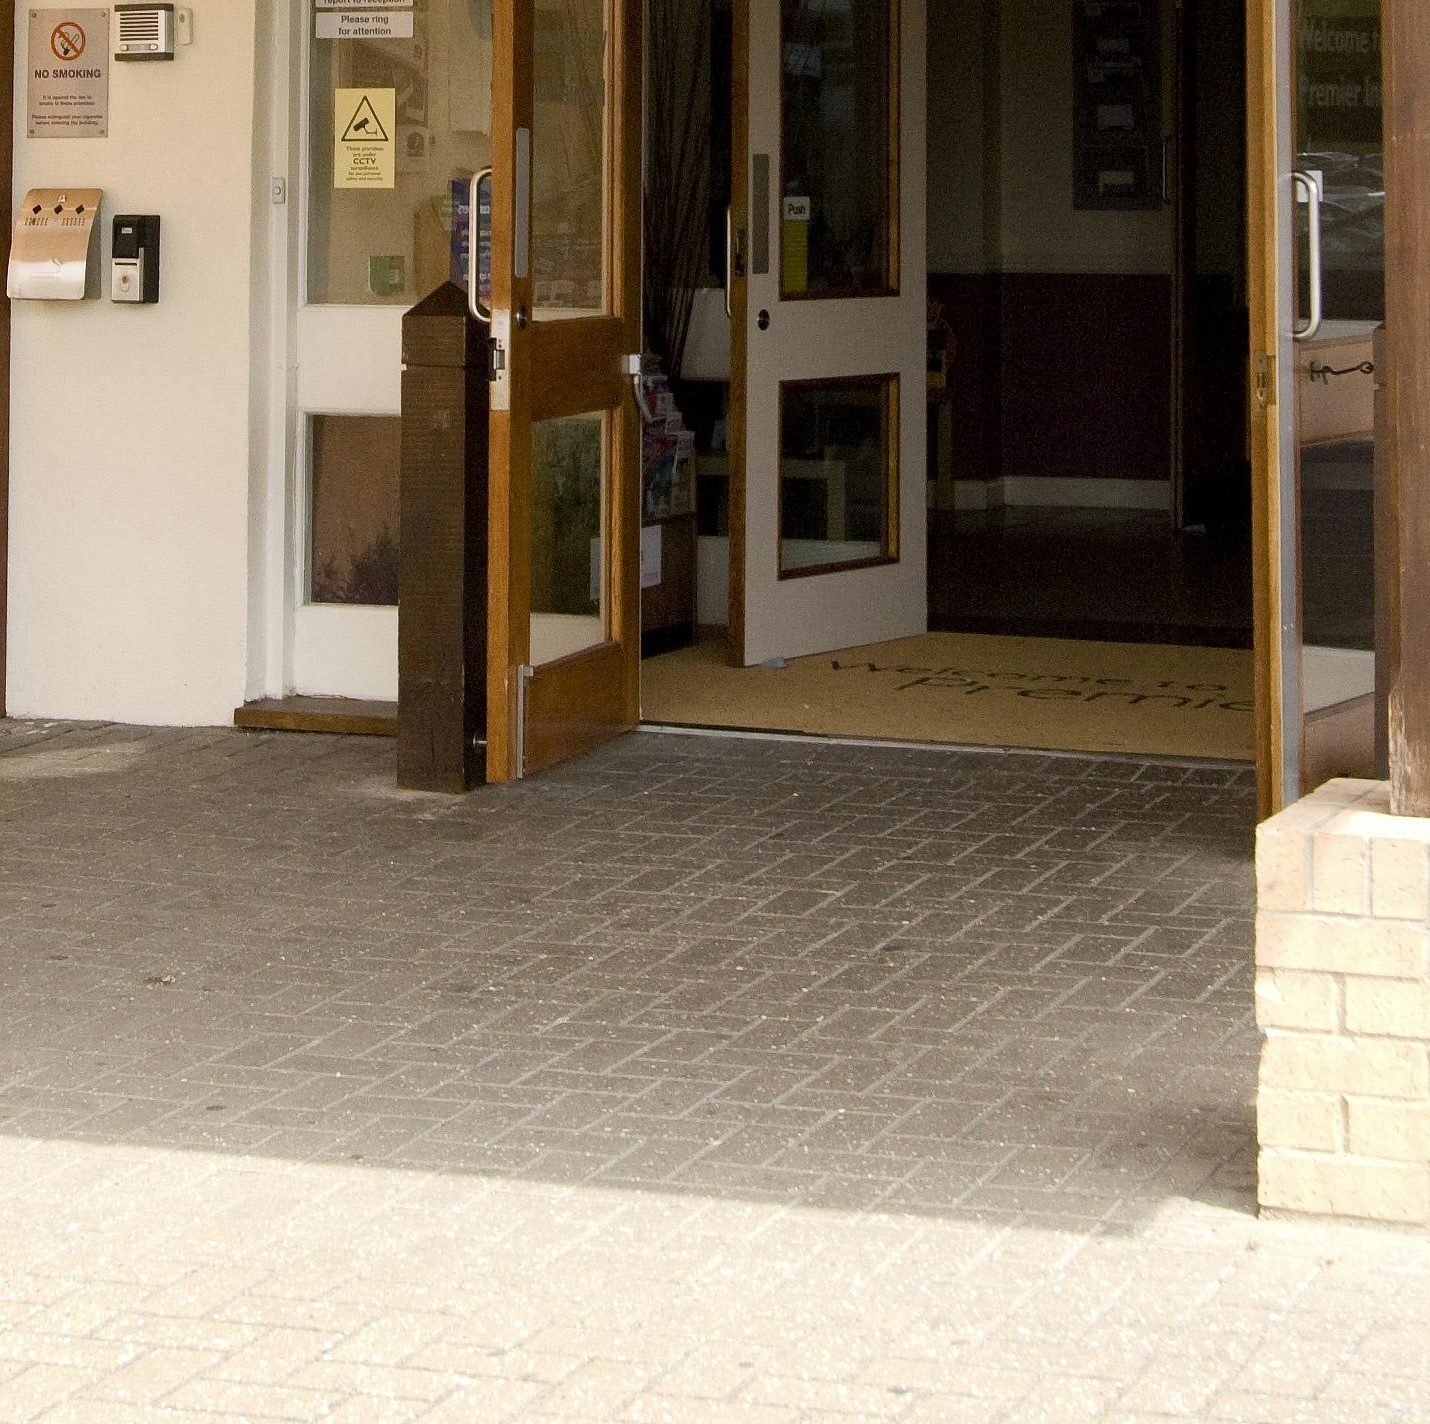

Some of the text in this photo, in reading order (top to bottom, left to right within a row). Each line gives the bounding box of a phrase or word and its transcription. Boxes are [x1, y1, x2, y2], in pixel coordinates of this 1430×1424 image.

[341, 15, 389, 24] Please ring
[338, 26, 392, 35] for attention
[34, 68, 102, 79] NO SMOKING
[352, 157, 377, 165] CCTV
[831, 659, 1132, 688] Welcome
[894, 674, 1255, 713] Premie
